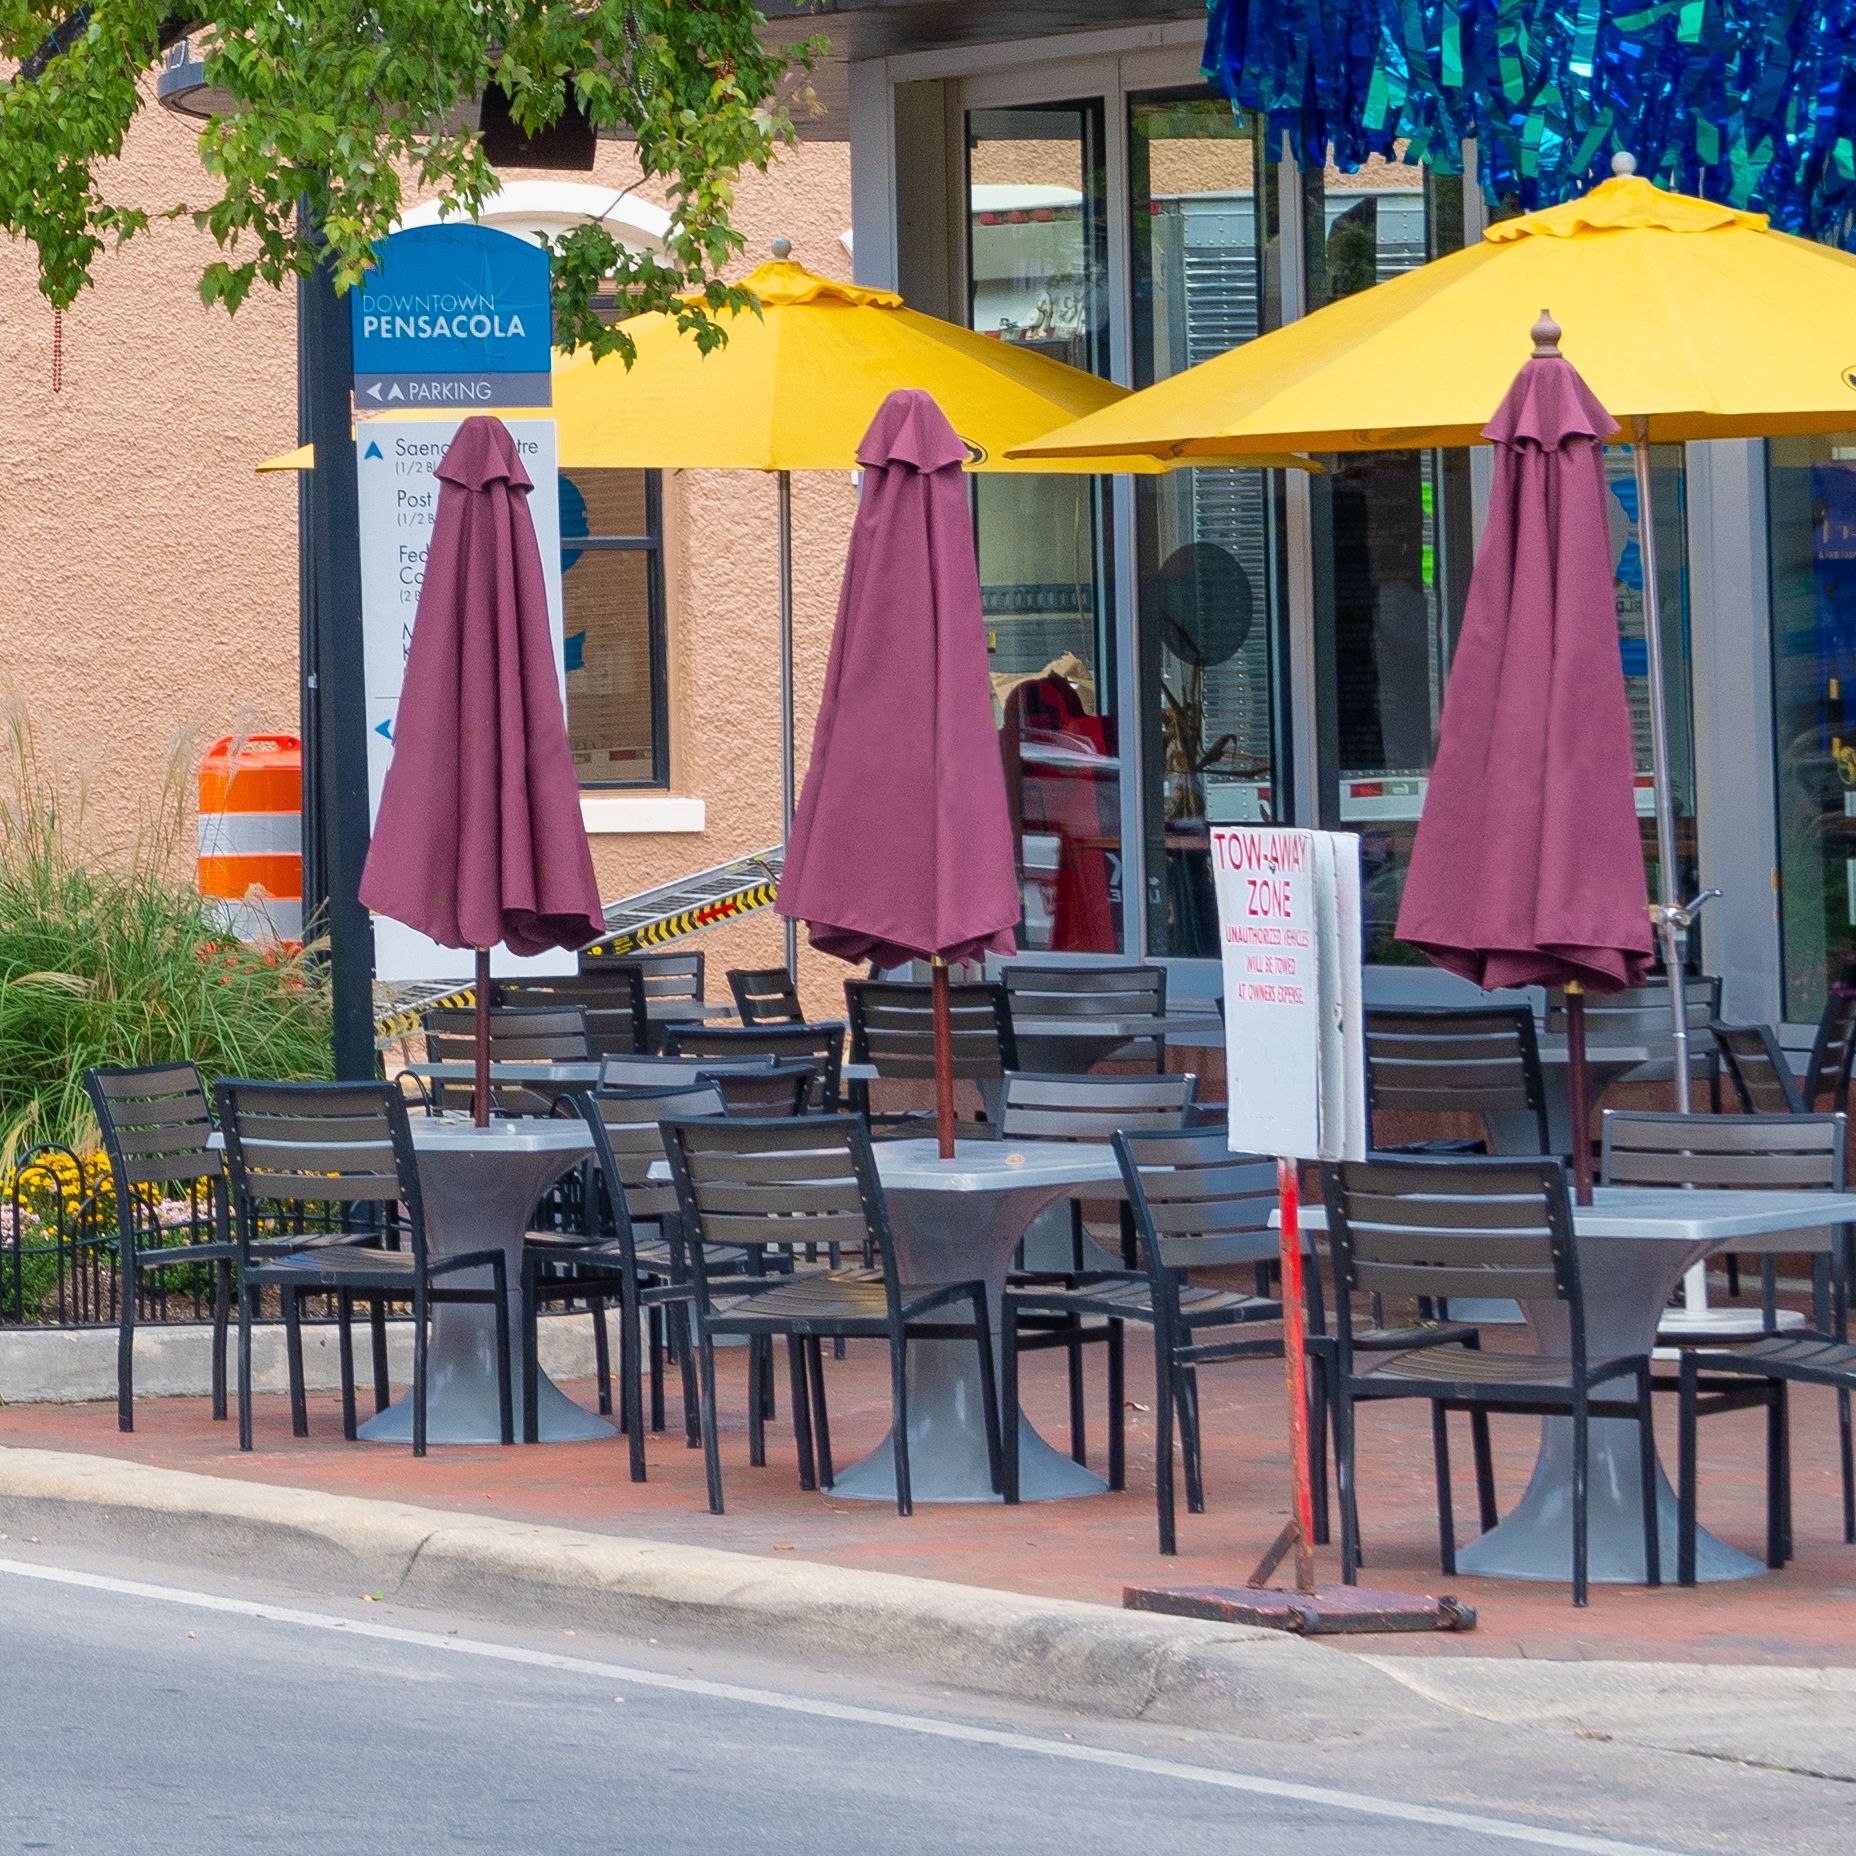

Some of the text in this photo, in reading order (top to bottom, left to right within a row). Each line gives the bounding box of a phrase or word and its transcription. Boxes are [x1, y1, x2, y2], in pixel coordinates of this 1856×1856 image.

[362, 294, 495, 312] DOWNTOWN
[363, 315, 526, 338] PENSACOLA
[408, 381, 493, 401] PARKING
[397, 489, 432, 508] Post
[1214, 833, 1307, 872] TOW-AWAY
[1247, 879, 1292, 918] ZONE
[1225, 927, 1281, 945] UNAUTHORIZED
[1246, 955, 1263, 973] WILL
